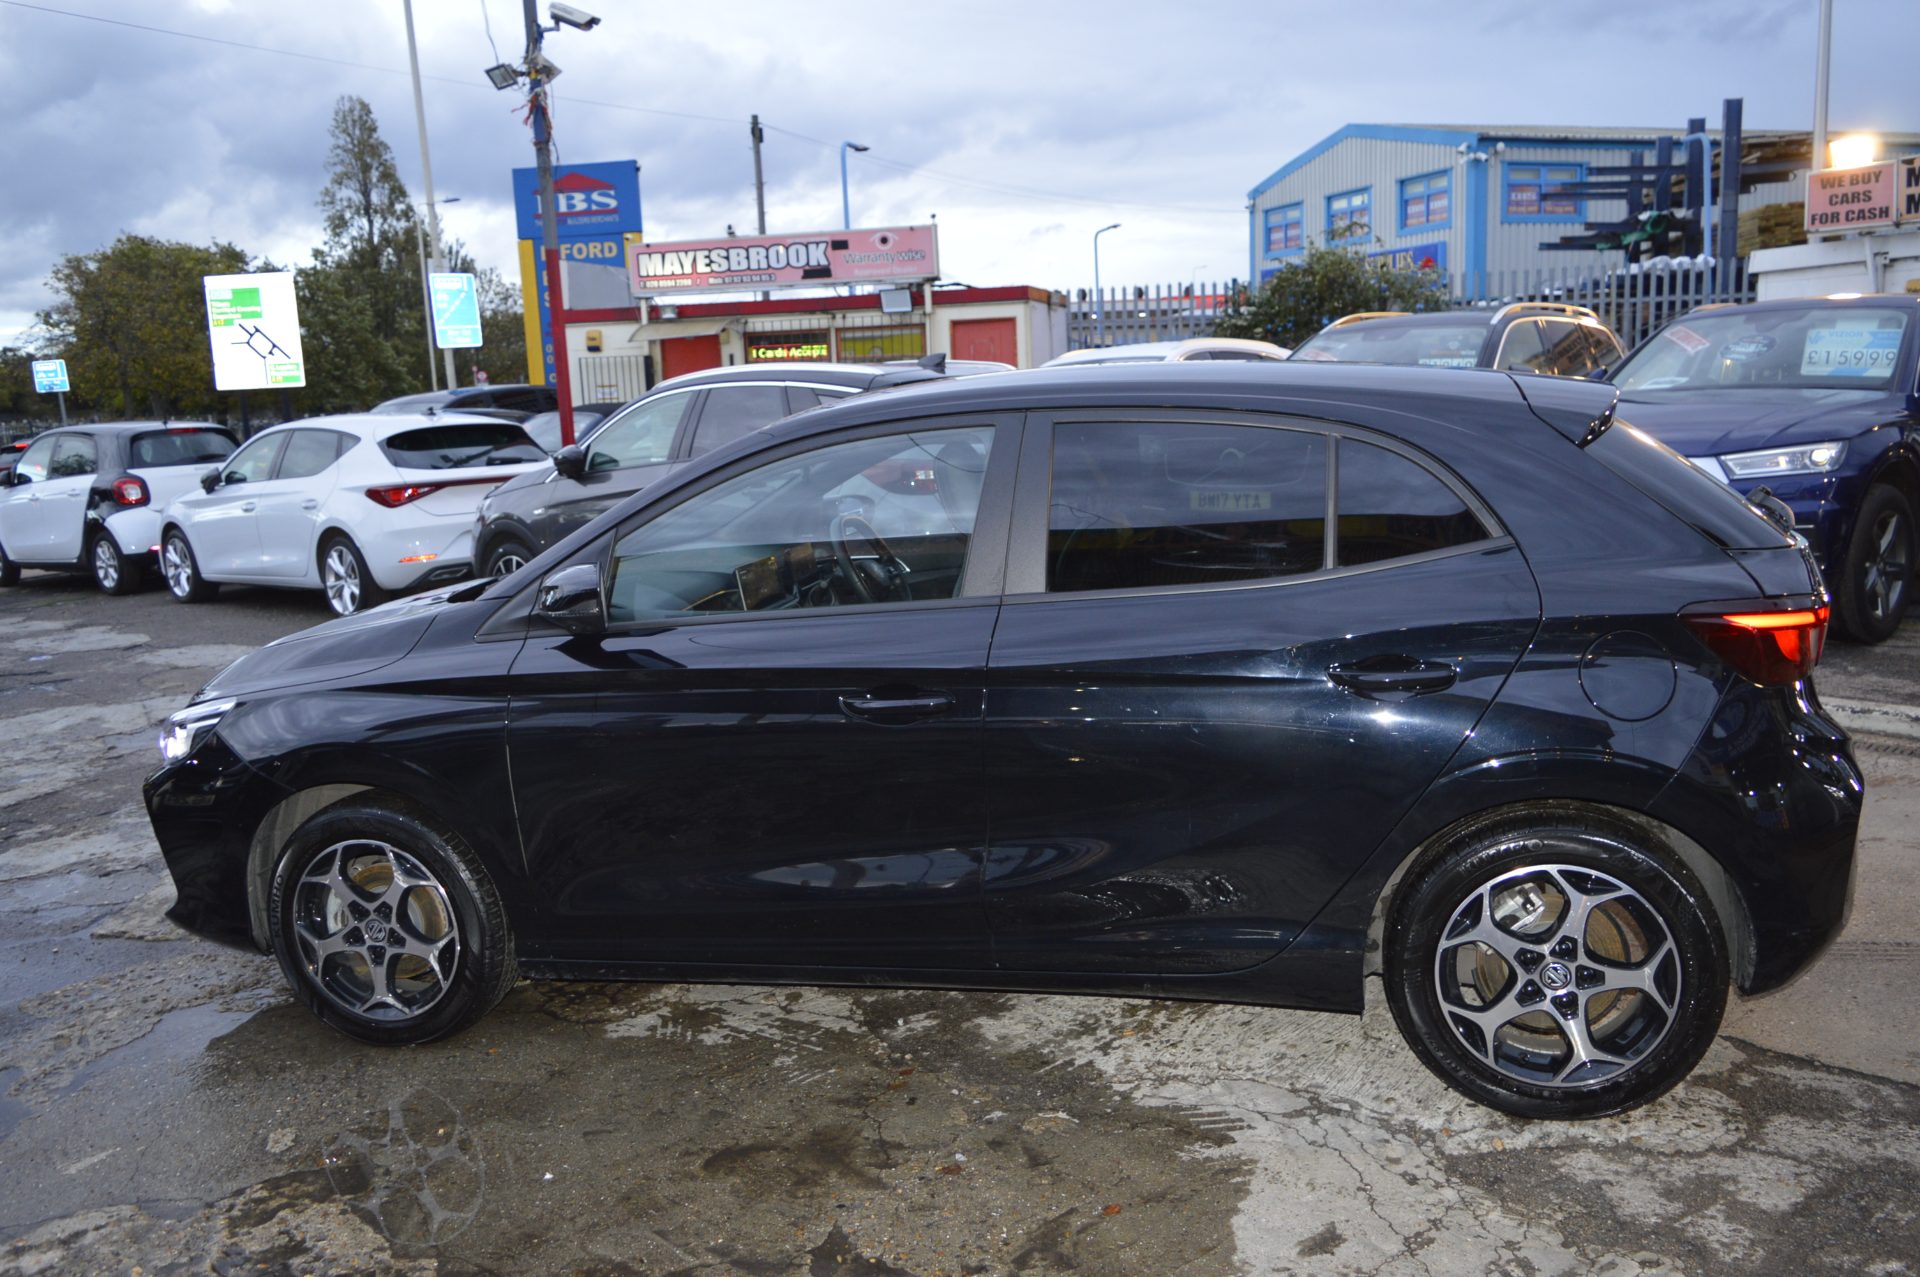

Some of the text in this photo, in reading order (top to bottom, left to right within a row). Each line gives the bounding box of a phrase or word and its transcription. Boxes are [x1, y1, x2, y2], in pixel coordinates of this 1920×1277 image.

[1820, 170, 1883, 190] WE BUY
[537, 189, 618, 214] BS
[1828, 189, 1873, 207] CARS
[1811, 206, 1890, 226] FOR CASH
[638, 241, 830, 278] MAYESBROOK
[1806, 349, 1896, 367] £15999
[271, 874, 284, 940] KUMHO
